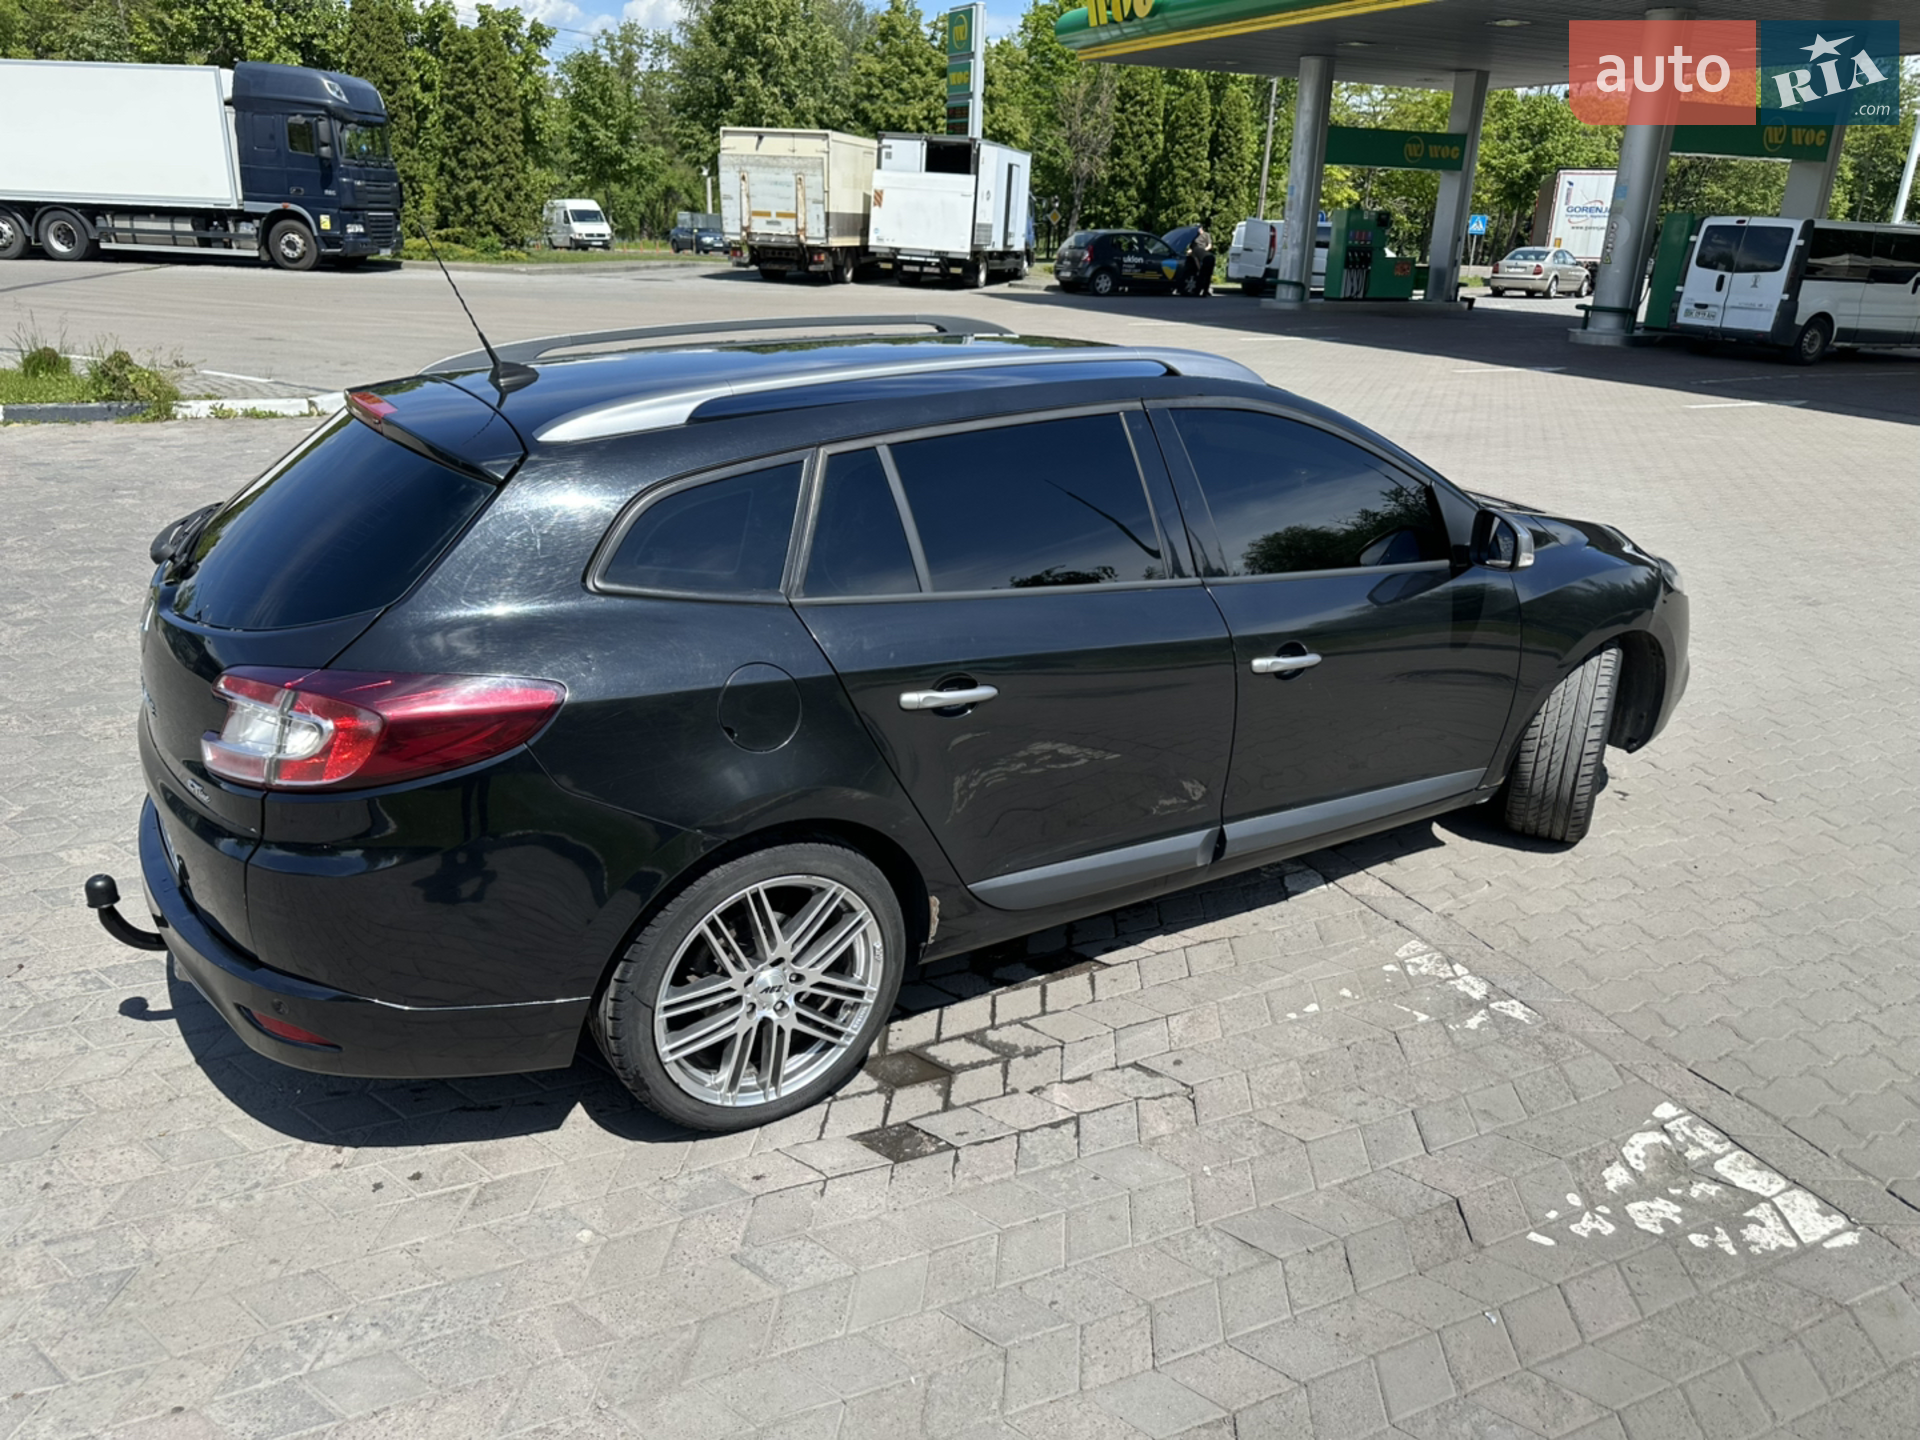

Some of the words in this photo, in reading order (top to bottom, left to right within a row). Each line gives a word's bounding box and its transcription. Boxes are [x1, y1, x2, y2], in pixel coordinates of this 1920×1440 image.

[1791, 127, 1827, 147] WOG
[1428, 144, 1460, 159] WOG
[1122, 255, 1144, 264] uklon
